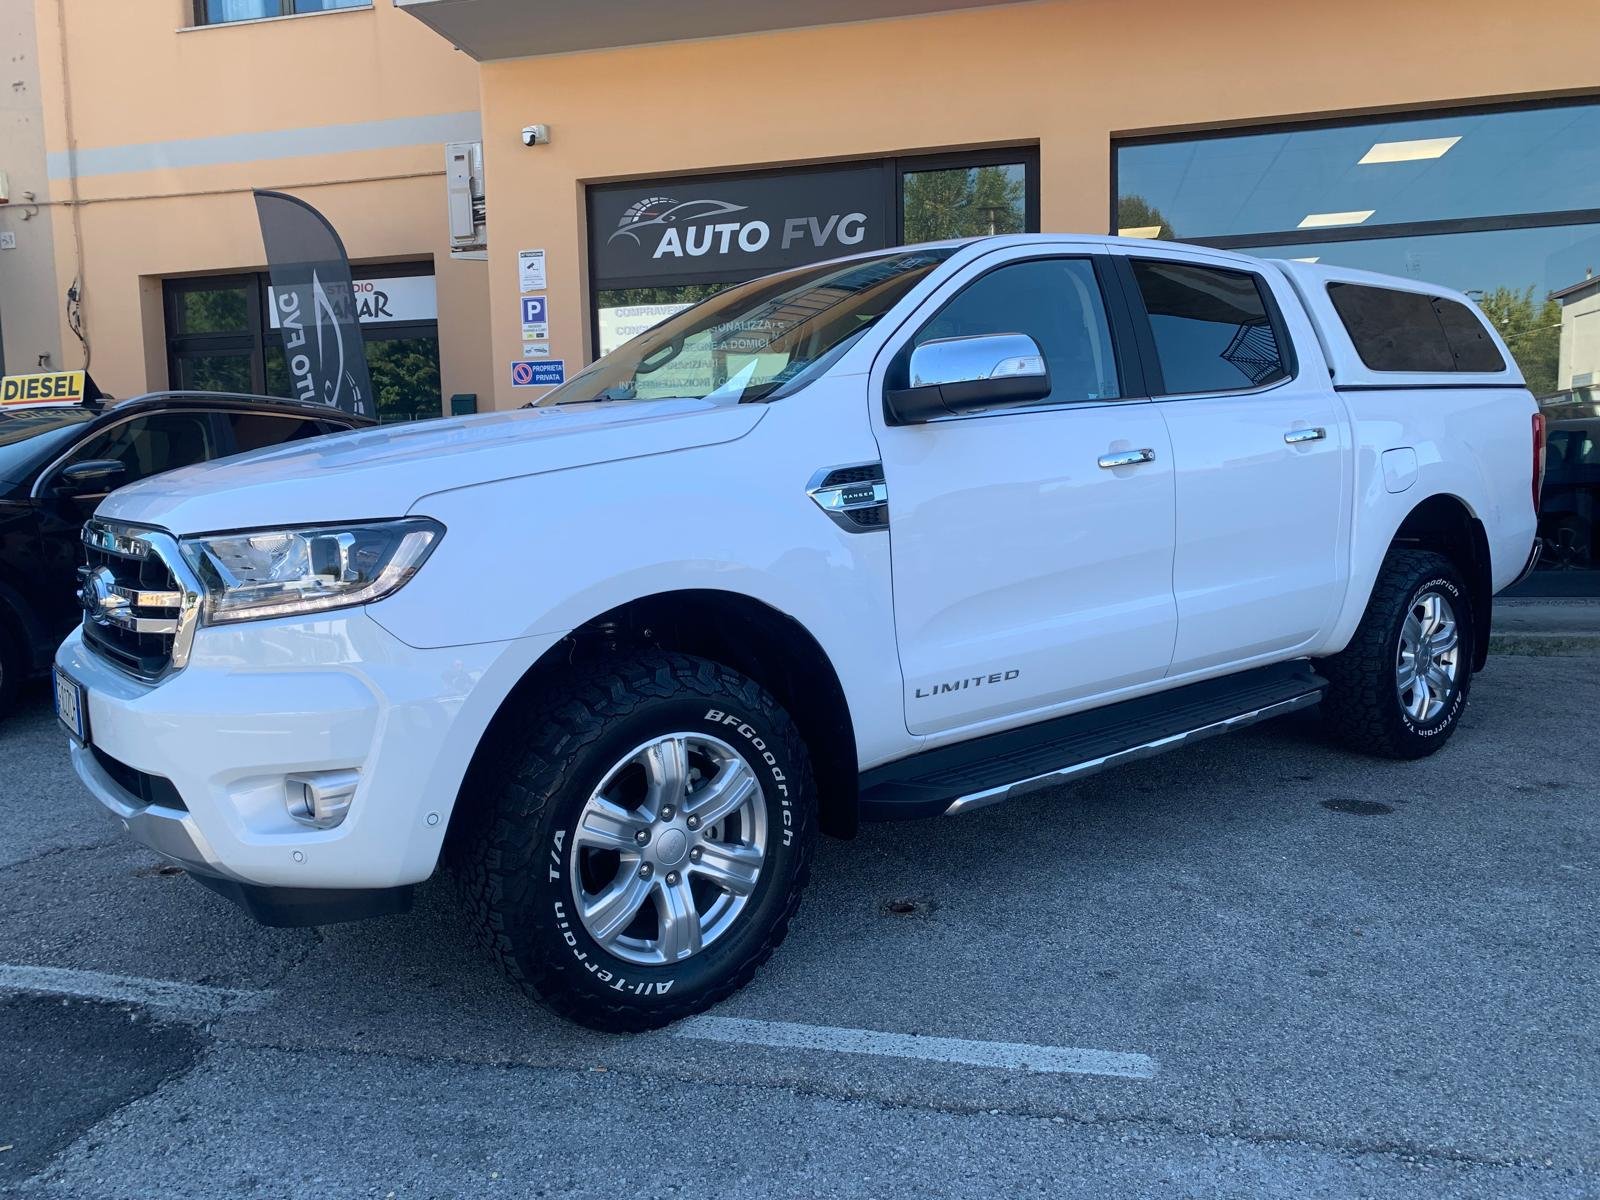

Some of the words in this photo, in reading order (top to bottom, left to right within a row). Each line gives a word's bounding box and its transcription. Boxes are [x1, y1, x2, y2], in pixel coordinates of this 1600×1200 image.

[653, 220, 770, 259] AUTO
[781, 212, 868, 250] FVG
[327, 282, 374, 295] STUDIO
[527, 301, 541, 321] P
[3, 375, 80, 401] DIESEL
[535, 373, 561, 381] PRIVATA
[843, 491, 874, 499] RANGER
[915, 669, 1020, 698] LIMITED
[1418, 690, 1462, 738] All-Terrain
[703, 709, 794, 847] BFGoodrich
[549, 830, 566, 883] T/A
[554, 901, 675, 996] All-Terrain
